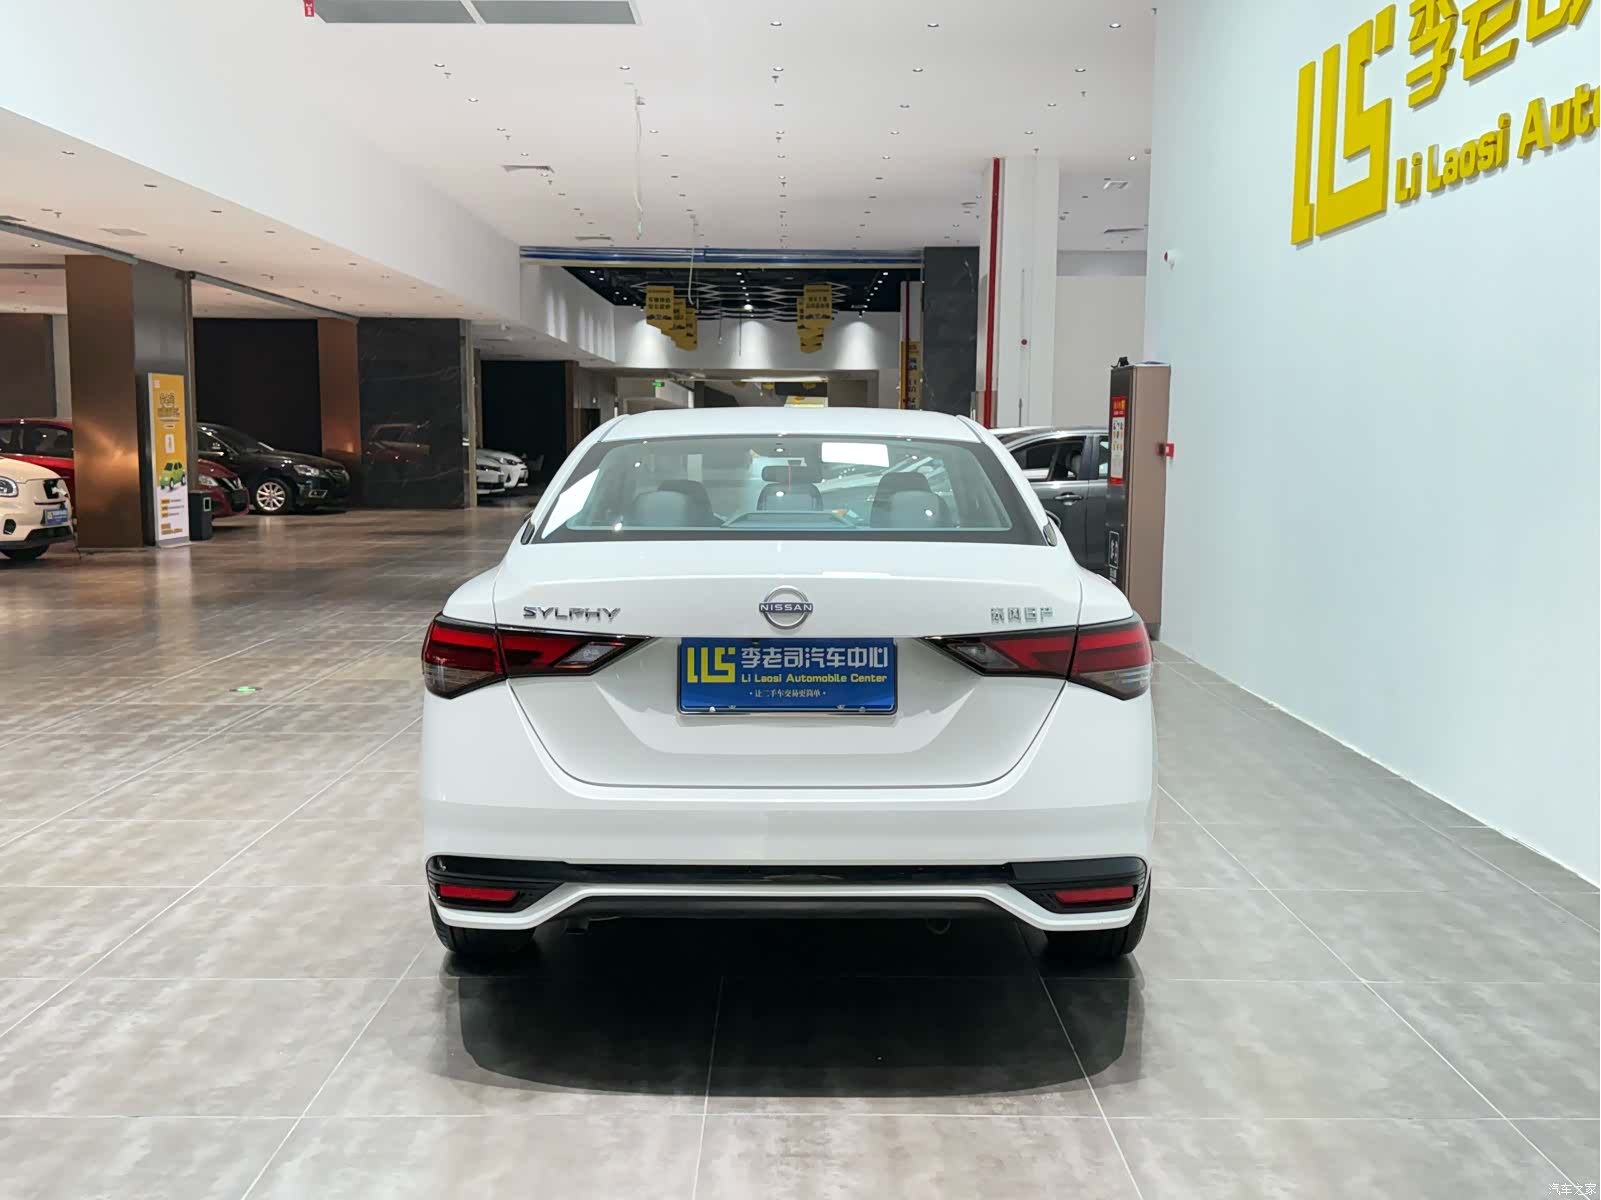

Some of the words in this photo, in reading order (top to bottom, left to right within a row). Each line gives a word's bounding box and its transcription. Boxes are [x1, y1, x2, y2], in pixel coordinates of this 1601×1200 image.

[1395, 152, 1423, 203] Li
[1427, 113, 1511, 192] Laosi
[523, 606, 621, 622] SYLPHY
[741, 647, 888, 668] 李老司汽车中心
[741, 674, 751, 683] Li
[754, 674, 782, 683] Laosi
[785, 674, 847, 683] Automobile
[850, 674, 887, 683] Center
